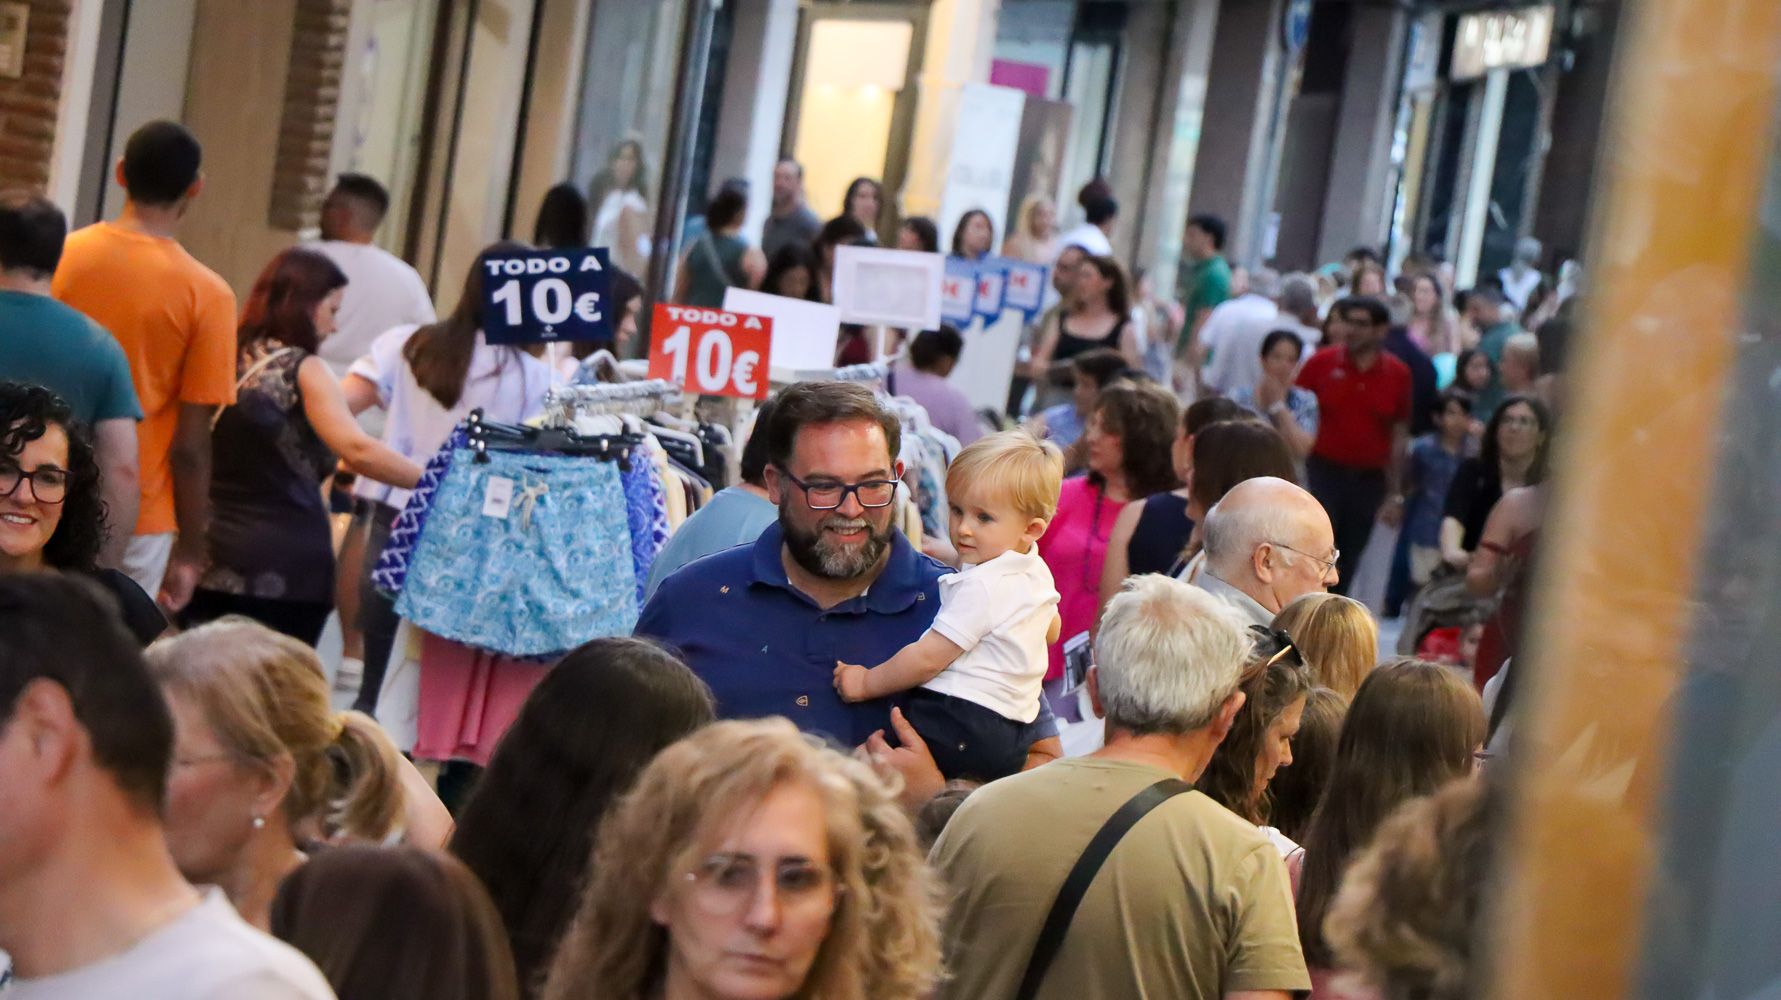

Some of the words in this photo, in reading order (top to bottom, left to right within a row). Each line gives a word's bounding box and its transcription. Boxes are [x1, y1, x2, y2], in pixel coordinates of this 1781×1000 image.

[485, 256, 571, 276] TODO
[580, 255, 602, 272] A
[492, 278, 602, 325] 10€
[667, 306, 737, 327] TODO
[744, 315, 762, 330] A
[662, 325, 760, 395] 10€
